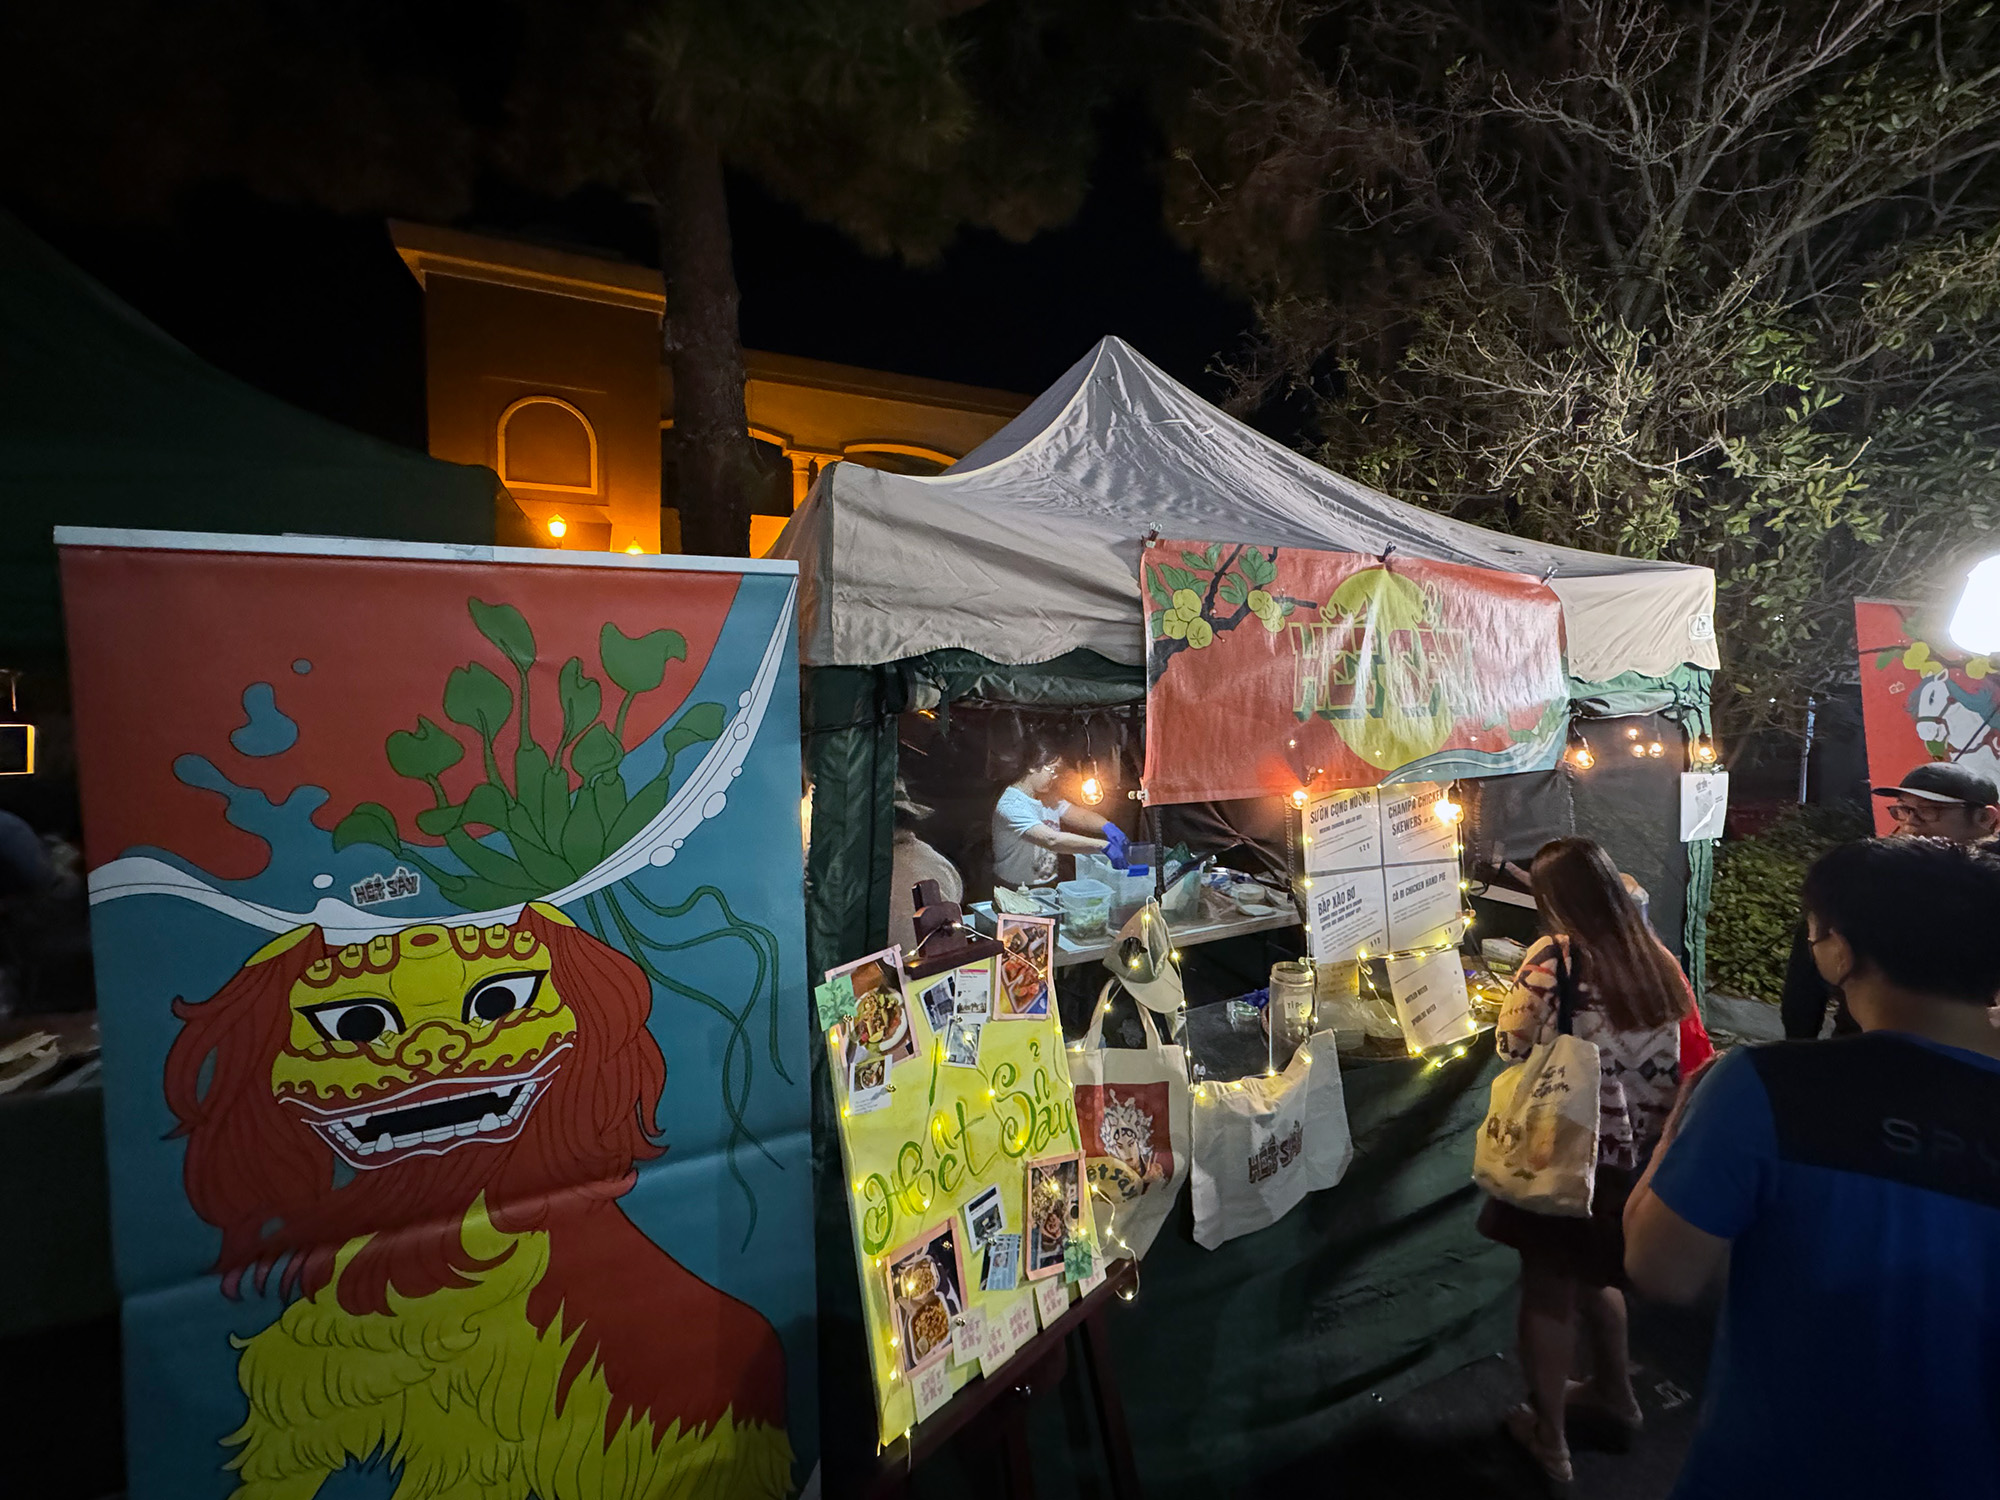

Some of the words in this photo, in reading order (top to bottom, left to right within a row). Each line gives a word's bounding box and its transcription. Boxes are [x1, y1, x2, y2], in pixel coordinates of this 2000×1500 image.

[1388, 797, 1416, 819] CHAMPA
[1417, 788, 1444, 808] CHICKEN
[1392, 814, 1422, 836] SKEWERS
[1405, 881, 1425, 896] CHICKEN
[1425, 875, 1438, 888] HAND
[1438, 871, 1447, 882] PIE
